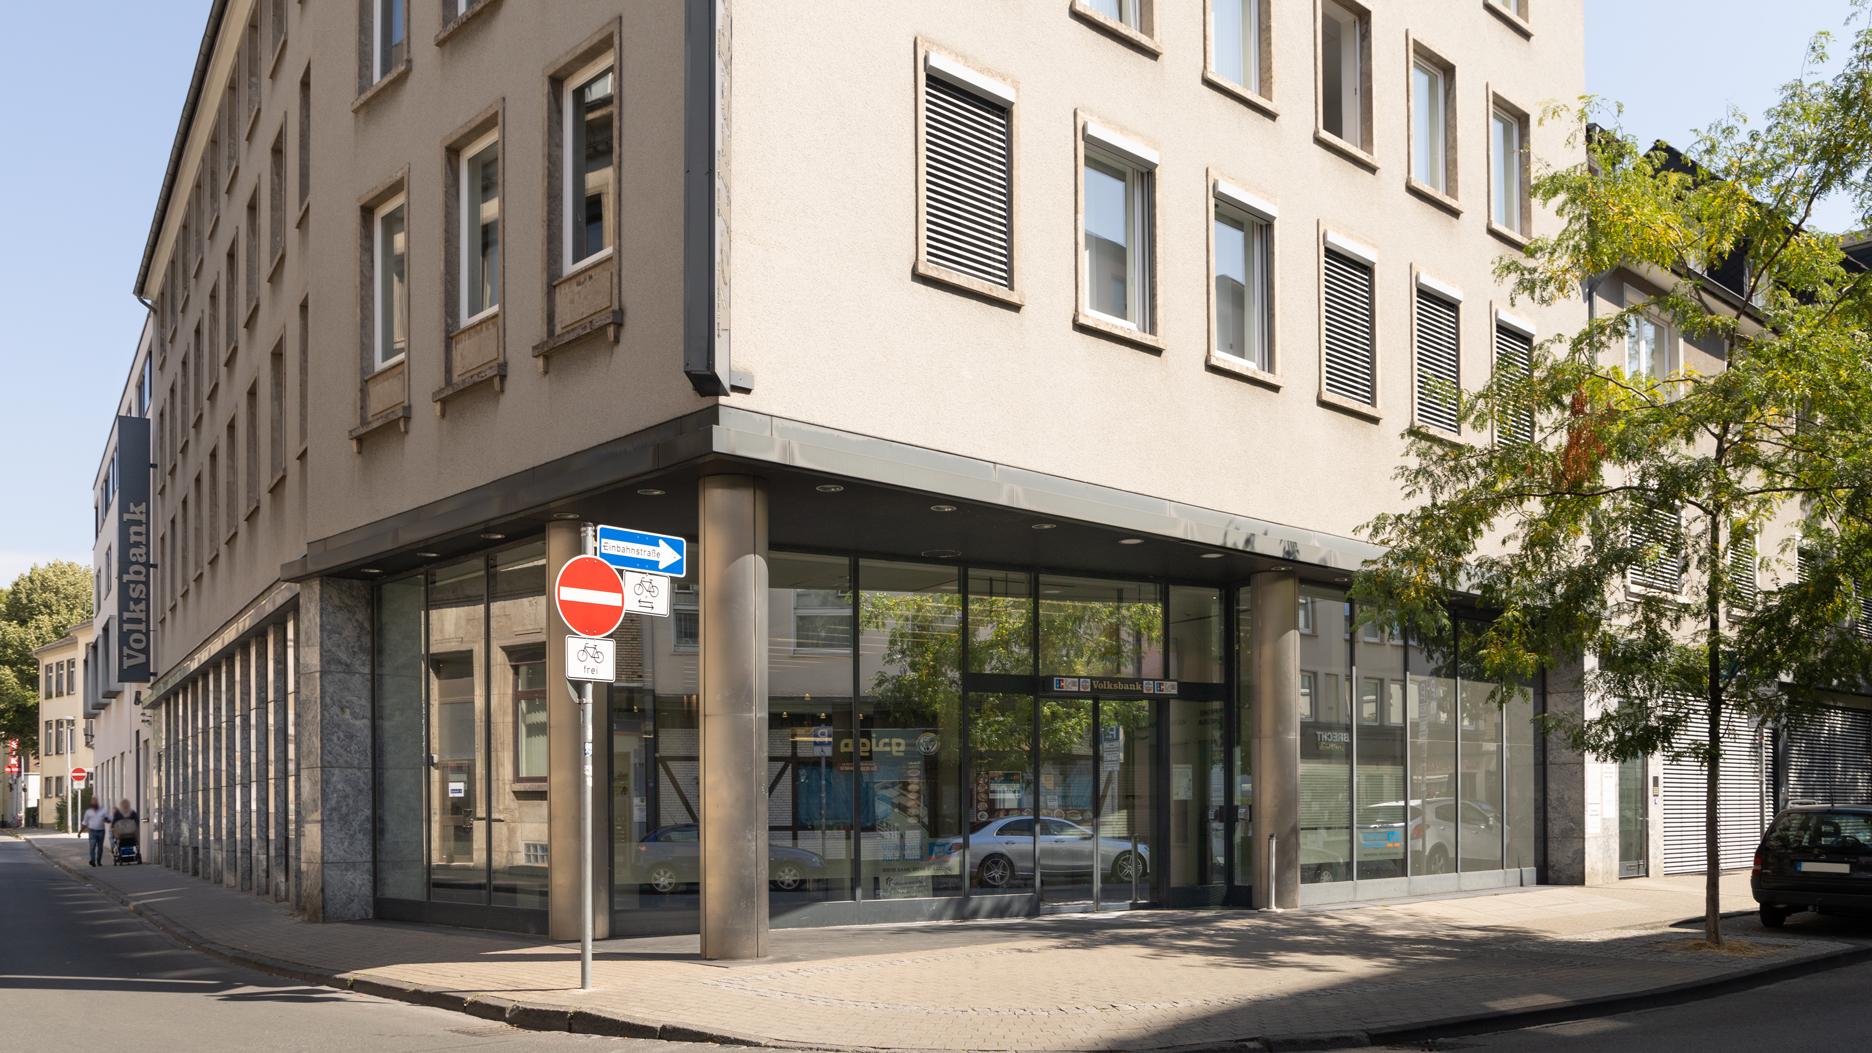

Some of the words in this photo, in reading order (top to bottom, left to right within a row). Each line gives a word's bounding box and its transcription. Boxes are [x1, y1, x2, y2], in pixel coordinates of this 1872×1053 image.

[602, 541, 660, 559] Einbahnstraße
[122, 501, 147, 669] Volksbank
[583, 664, 599, 675] frei
[1091, 680, 1142, 690] Volksbank
